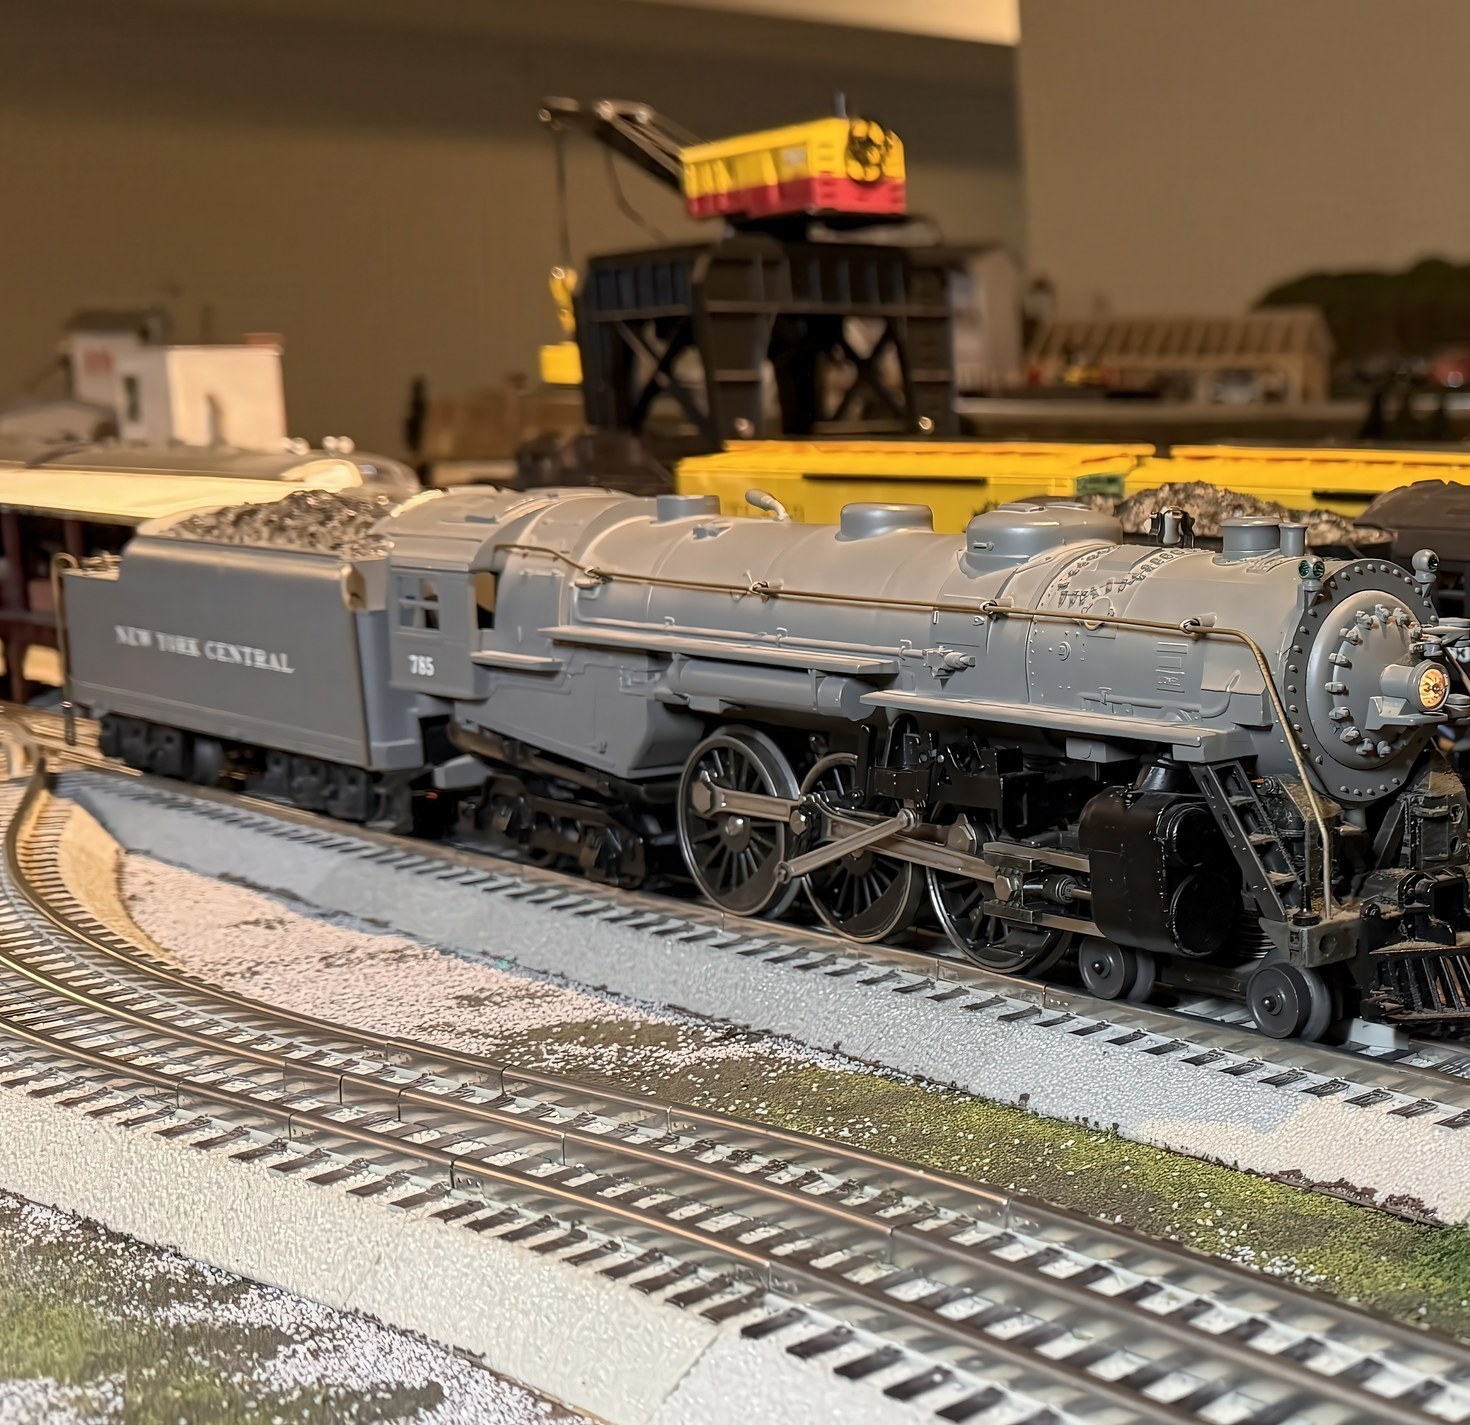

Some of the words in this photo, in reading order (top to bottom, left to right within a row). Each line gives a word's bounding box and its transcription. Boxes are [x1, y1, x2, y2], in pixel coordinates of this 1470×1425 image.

[114, 624, 153, 647] NEW
[155, 631, 201, 658] YORK
[204, 640, 296, 674] CENTRAL
